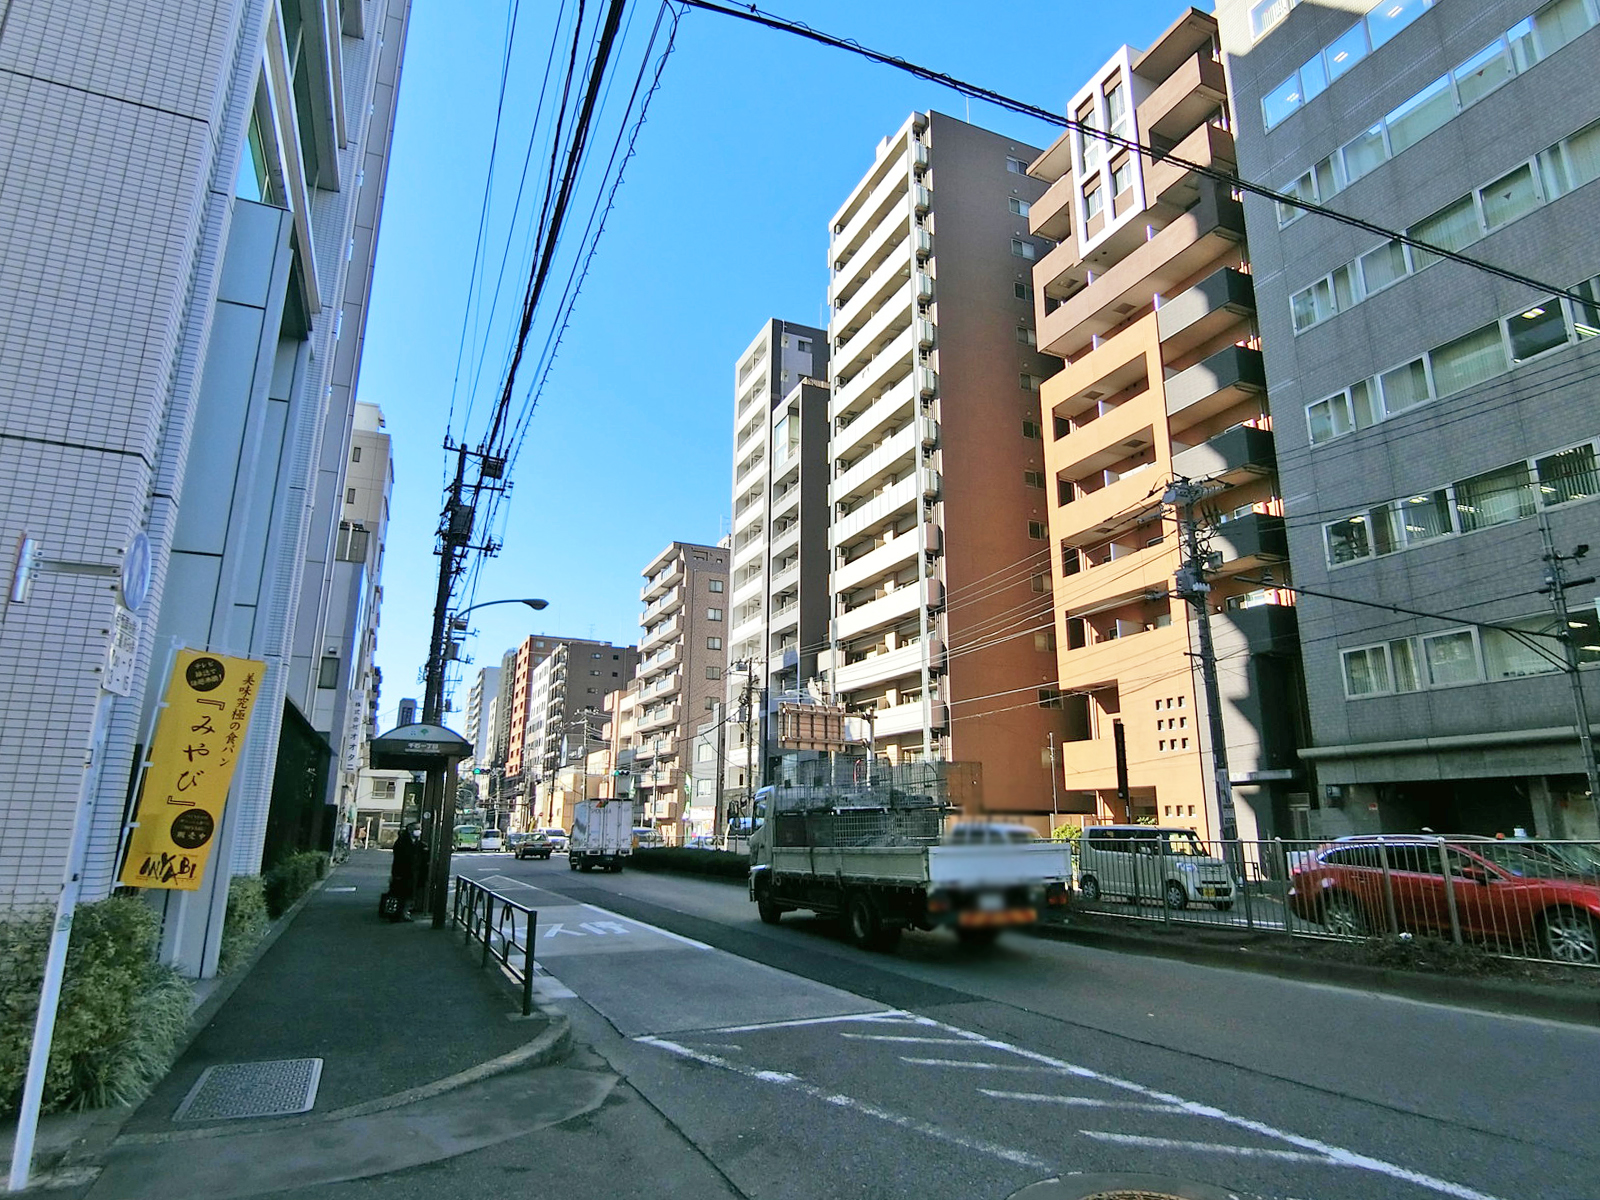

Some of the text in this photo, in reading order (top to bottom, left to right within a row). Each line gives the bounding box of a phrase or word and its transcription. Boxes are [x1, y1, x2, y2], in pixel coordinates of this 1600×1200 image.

[219, 672, 255, 767] 美味究極の食パン
